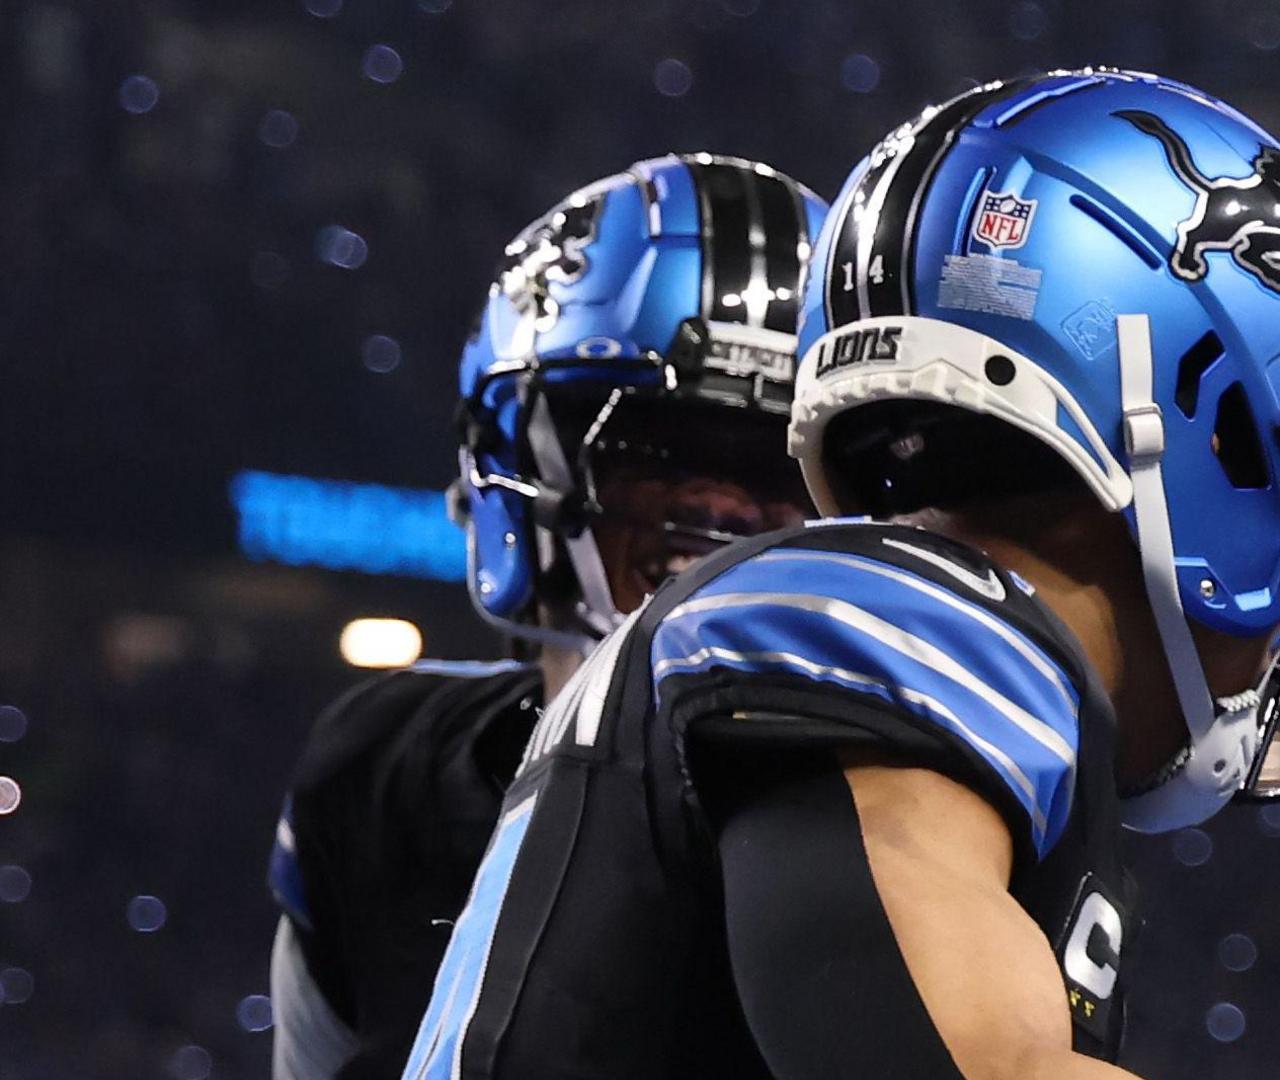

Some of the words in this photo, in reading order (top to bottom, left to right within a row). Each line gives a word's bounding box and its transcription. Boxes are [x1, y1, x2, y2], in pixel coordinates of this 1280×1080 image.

[981, 212, 1021, 242] NFL
[814, 325, 903, 380] LIONS
[1064, 891, 1123, 1000] C
